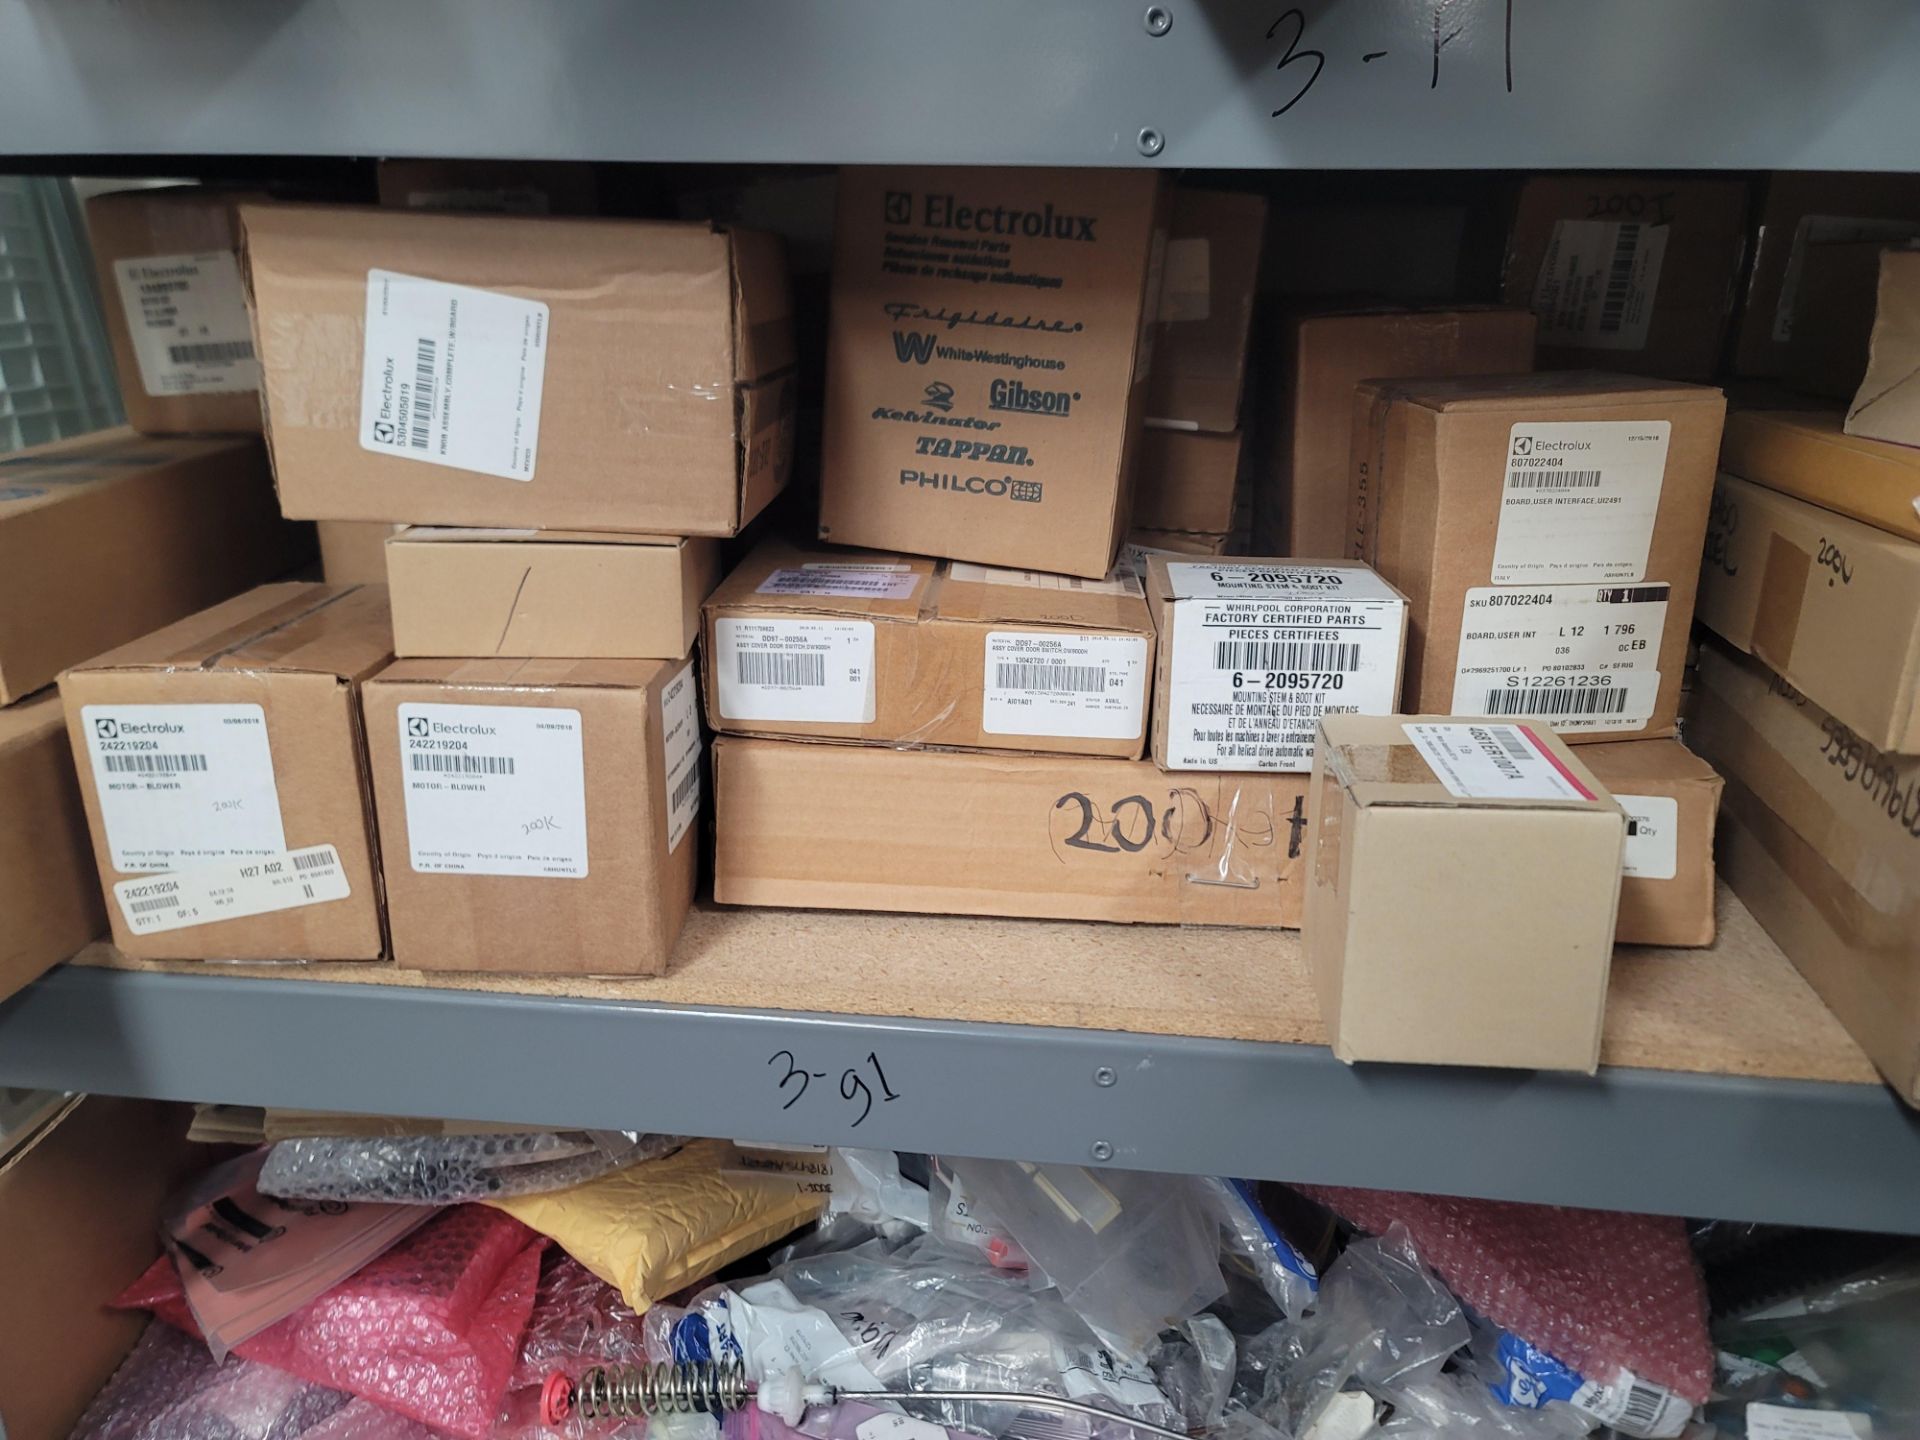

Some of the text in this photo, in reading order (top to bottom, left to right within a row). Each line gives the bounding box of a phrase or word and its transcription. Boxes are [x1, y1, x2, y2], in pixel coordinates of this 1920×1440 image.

[924, 194, 1098, 243] Electrolux
[884, 302, 1073, 334] Frigidaire
[936, 345, 1066, 371] White-Westinghouse
[379, 357, 395, 420] Electrolux
[989, 378, 1071, 414] Gibson
[397, 383, 411, 447] 5304505019
[871, 406, 1001, 432] Kelvinator
[915, 436, 1028, 467] TAPPAN
[1535, 440, 1591, 451] Electrolux
[1511, 457, 1564, 468] 807022404
[900, 469, 1007, 497] PHILCO
[1469, 599, 1487, 608] SKU
[1488, 594, 1553, 607] 807022404
[1621, 589, 1629, 602] 1
[1226, 604, 1352, 614] WHIRLPOOL CORPORATION
[1205, 613, 1366, 626] FACTORY CERTIFIED PARTS
[1229, 630, 1340, 641] PIECES CERTIFIEES
[1522, 631, 1537, 640] INT
[1559, 627, 1566, 637] L
[1571, 626, 1585, 637] 12
[1603, 625, 1610, 636] 1
[1614, 624, 1635, 636] 796
[1555, 646, 1571, 655] 036
[1631, 639, 1647, 650] EB
[848, 667, 860, 676] 041
[1109, 678, 1124, 688] 041
[1506, 676, 1613, 687] S12261236
[1232, 691, 1326, 705] MOUNTING STEM & BOOT KIT
[1191, 703, 1233, 716] NECESSAIRE
[1235, 703, 1244, 716] DE
[1246, 704, 1280, 717] MONTAGE
[1282, 704, 1293, 717] DU
[1294, 705, 1312, 717] PIED
[1313, 705, 1322, 717] DE
[120, 721, 185, 735] Electrolux
[432, 722, 497, 738] Electrolux
[1228, 718, 1236, 729] ET
[1237, 718, 1247, 729] DE
[1193, 730, 1206, 743] Pour
[1207, 730, 1224, 742] toutes
[1225, 730, 1234, 742] les
[1235, 731, 1260, 743] machines
[100, 741, 160, 751] 242219204
[409, 739, 469, 752] 242219204
[1217, 744, 1228, 756] For
[1237, 745, 1257, 757] helical
[1258, 745, 1275, 757] drive
[1275, 745, 1303, 757] automatic
[1258, 760, 1279, 768] Carton
[109, 782, 182, 791] MOTOR BLOWER
[412, 782, 487, 793] MOTOR BLOWER
[1639, 825, 1658, 838] Qty
[445, 863, 466, 871] CHINA
[124, 861, 284, 900] 242219204 H27 A02
